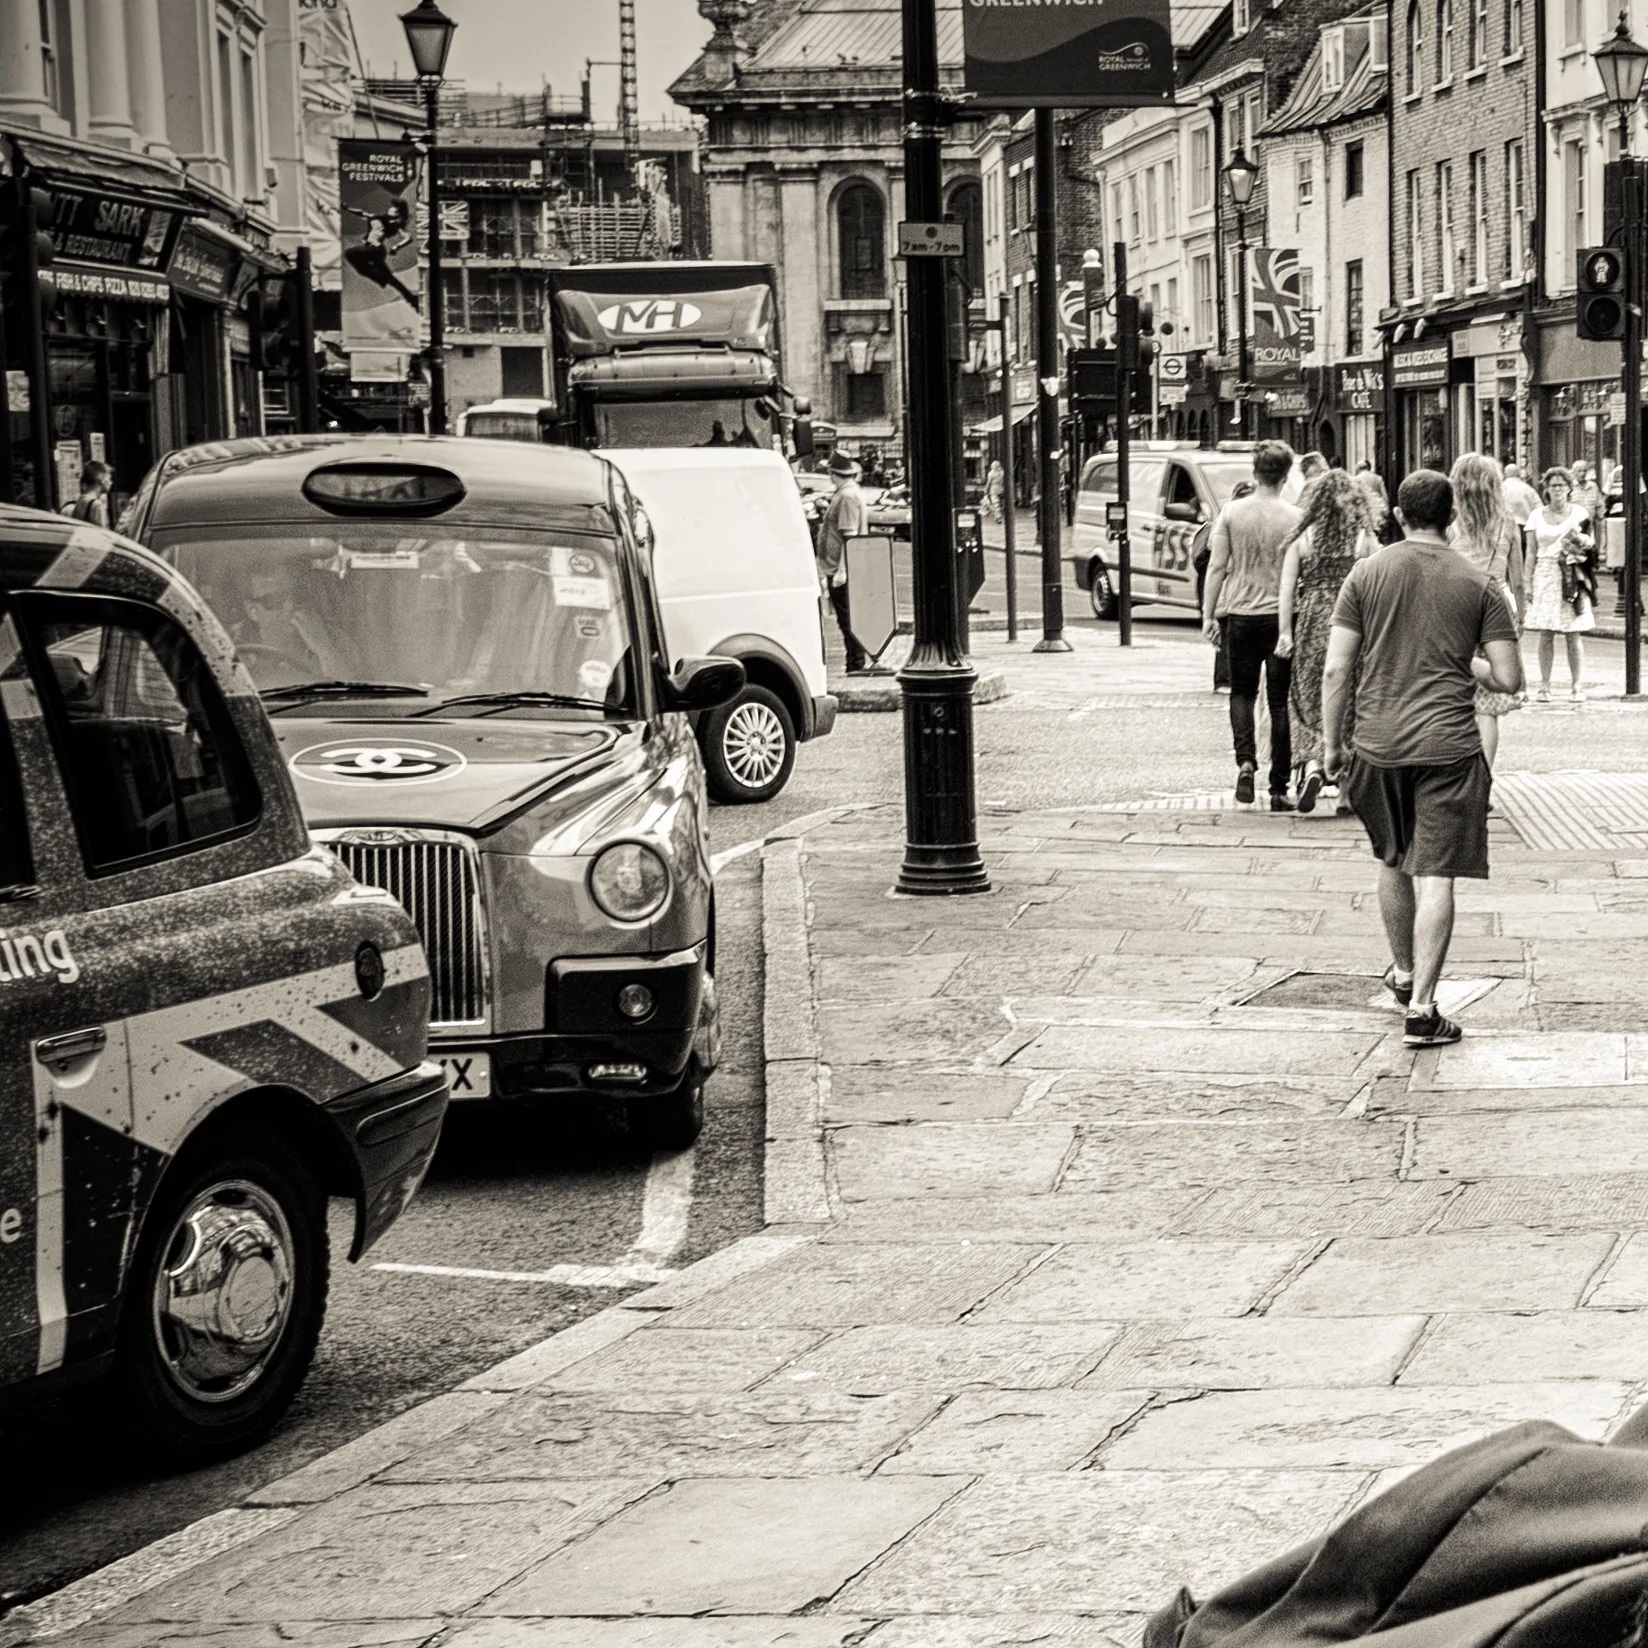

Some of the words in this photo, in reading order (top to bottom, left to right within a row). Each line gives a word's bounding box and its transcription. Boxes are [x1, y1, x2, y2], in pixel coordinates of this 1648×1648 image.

[369, 154, 403, 163] ROYAL
[342, 162, 404, 172] GREENWICH
[349, 172, 404, 182] FESTIVALS
[93, 200, 146, 238] SARK
[65, 233, 132, 262] RESTAURANT
[104, 277, 128, 295] PIZZA
[615, 300, 684, 335] MH
[1254, 347, 1301, 361] ROYAL
